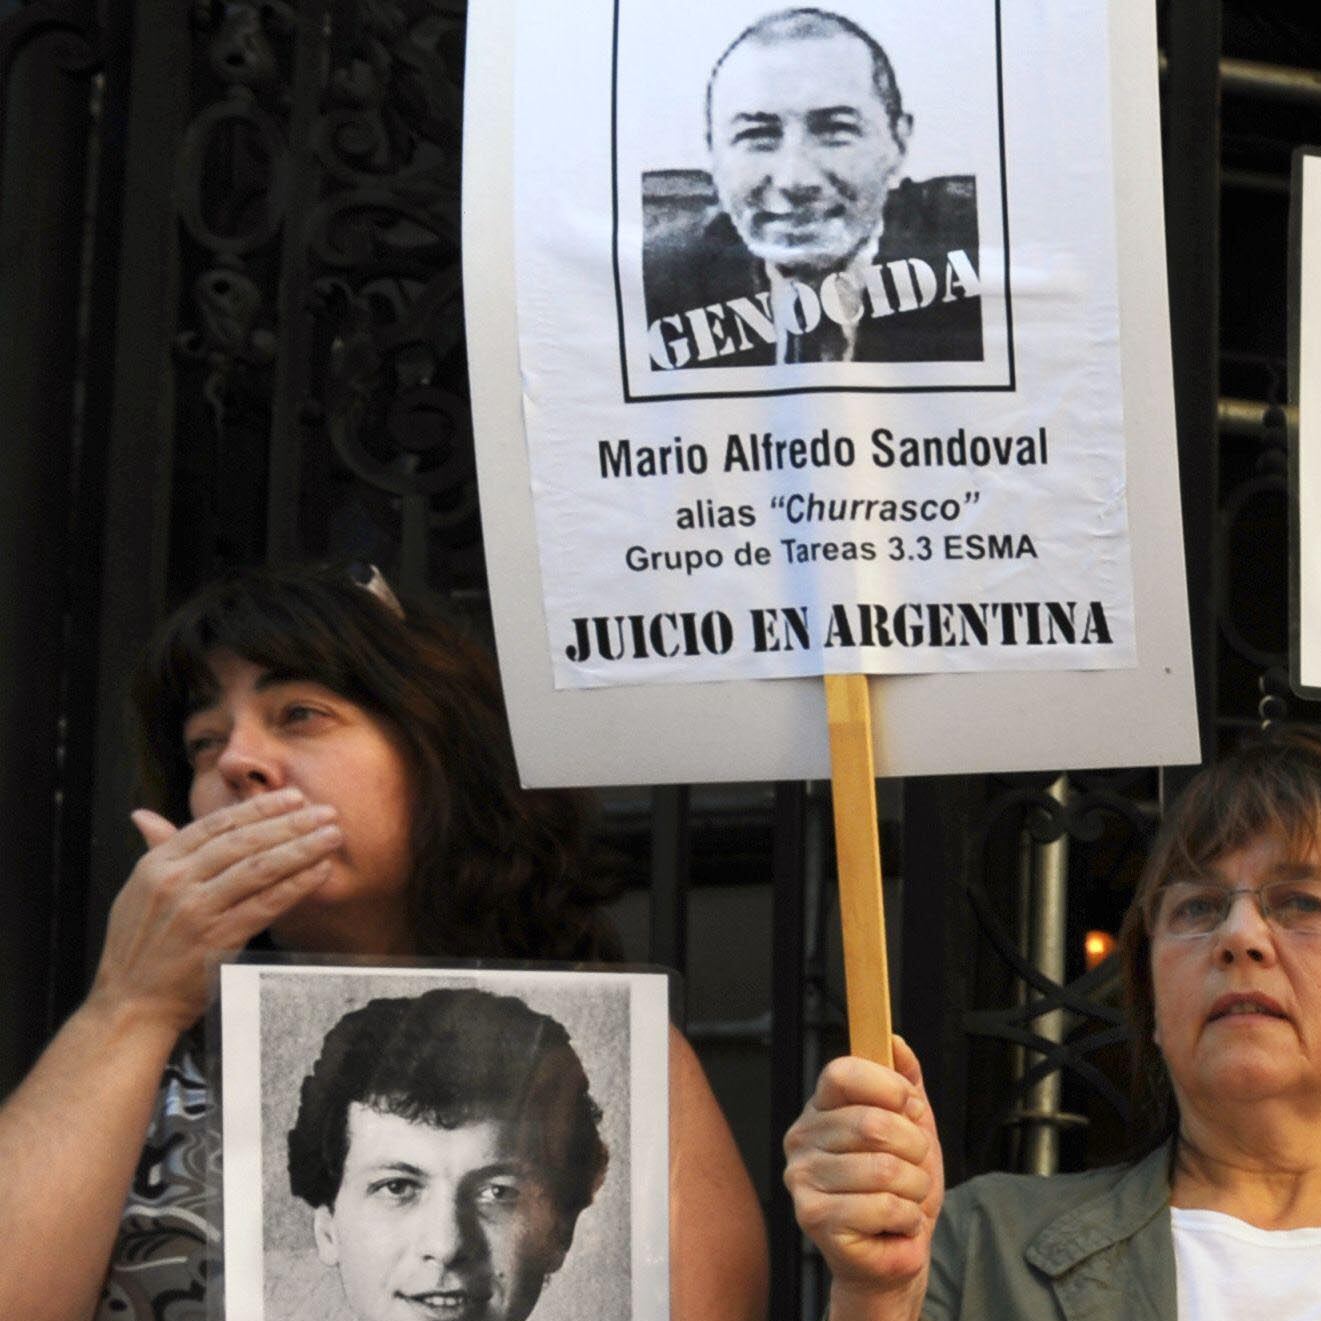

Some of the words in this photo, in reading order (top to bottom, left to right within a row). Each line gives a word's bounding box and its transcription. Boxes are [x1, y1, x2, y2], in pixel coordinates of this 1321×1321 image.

[649, 249, 980, 370] GENOCIDA
[598, 436, 709, 479] Mario
[723, 433, 855, 473] Alfredo
[871, 428, 1048, 468] Sandoval
[676, 498, 757, 530] alias
[625, 545, 724, 578] Grupo
[734, 541, 771, 567] de
[781, 536, 876, 564] Tareas
[888, 536, 933, 563] 3.3
[944, 534, 1038, 560] ESMA
[566, 609, 734, 662] JUICIO
[752, 607, 812, 652] EN
[822, 601, 1114, 648] ARGENTINA
